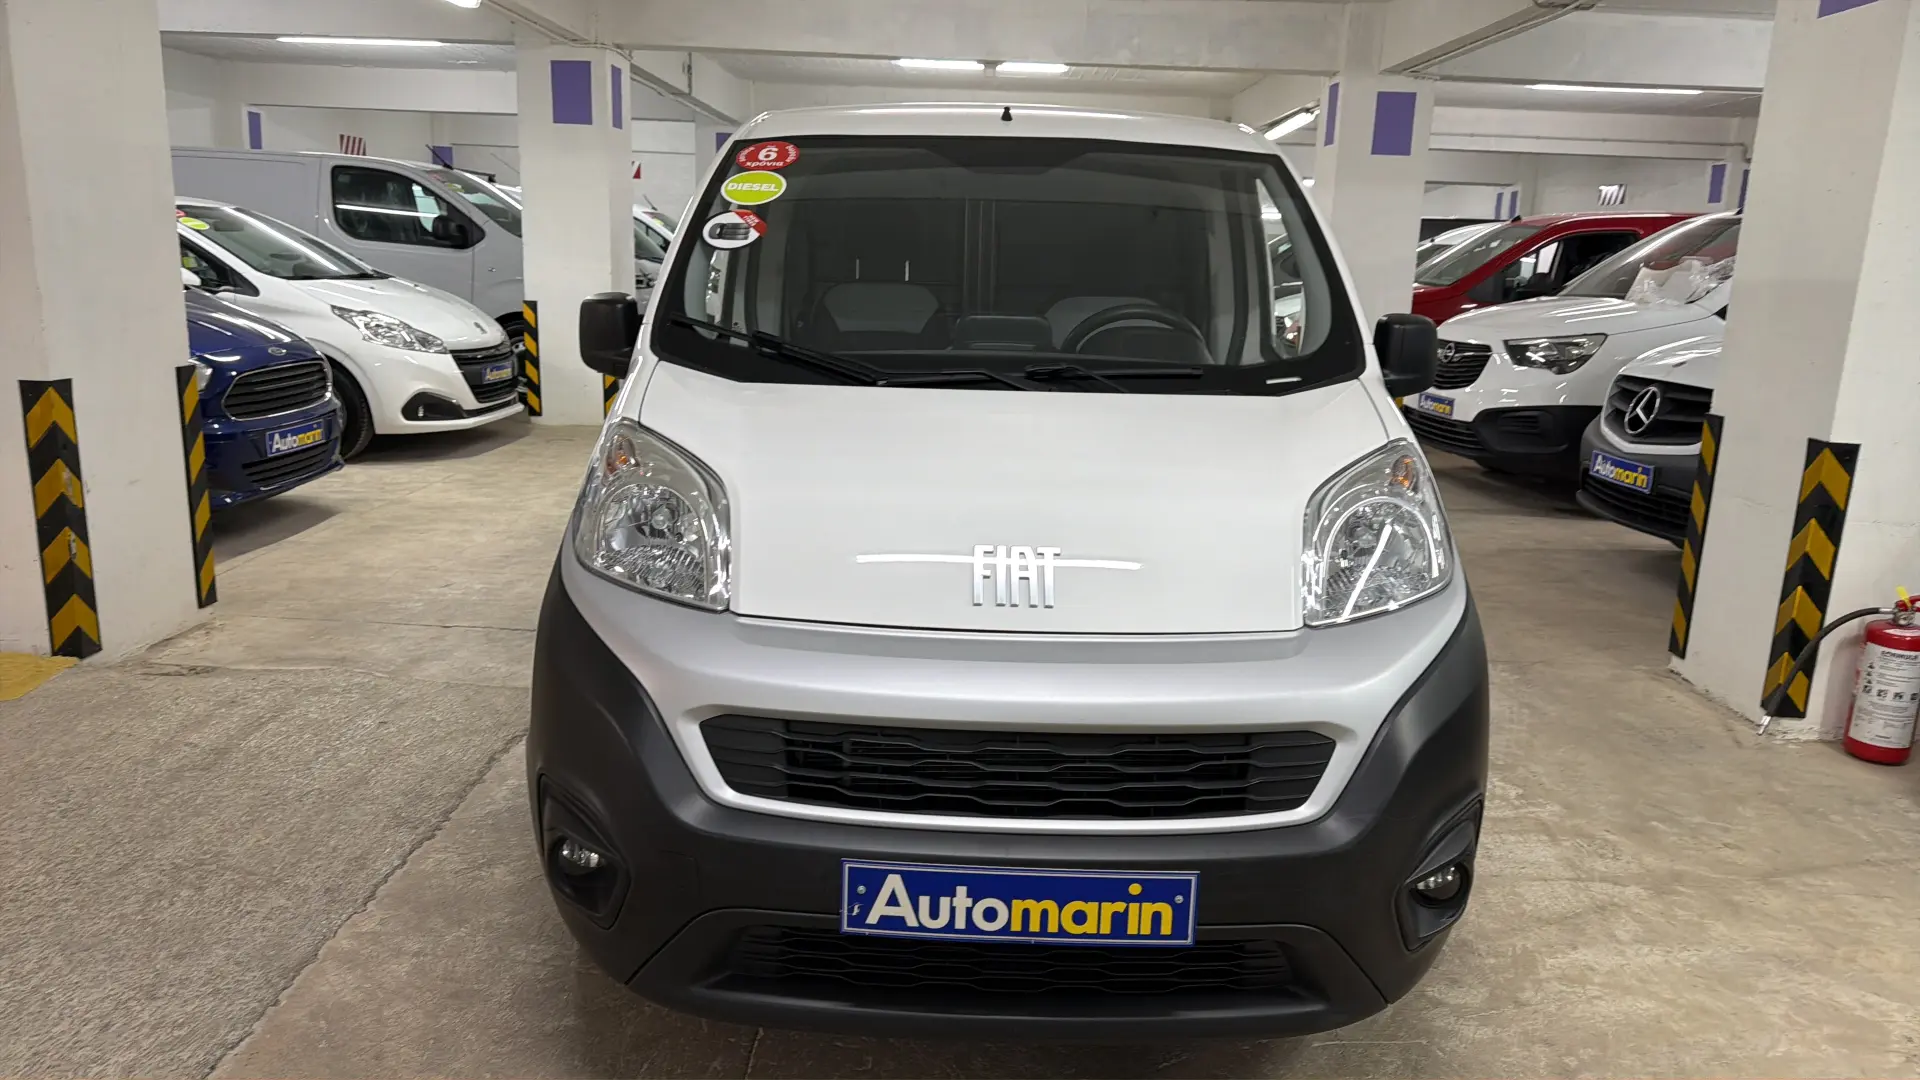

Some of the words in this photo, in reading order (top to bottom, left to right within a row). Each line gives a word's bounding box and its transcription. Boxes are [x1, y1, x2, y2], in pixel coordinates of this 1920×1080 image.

[758, 147, 778, 161] 6
[727, 182, 780, 192] DIESEL
[271, 424, 322, 453] Automarin
[1593, 454, 1648, 488] Automarin
[972, 544, 1061, 608] FIAT
[865, 873, 1173, 936] Automarin
